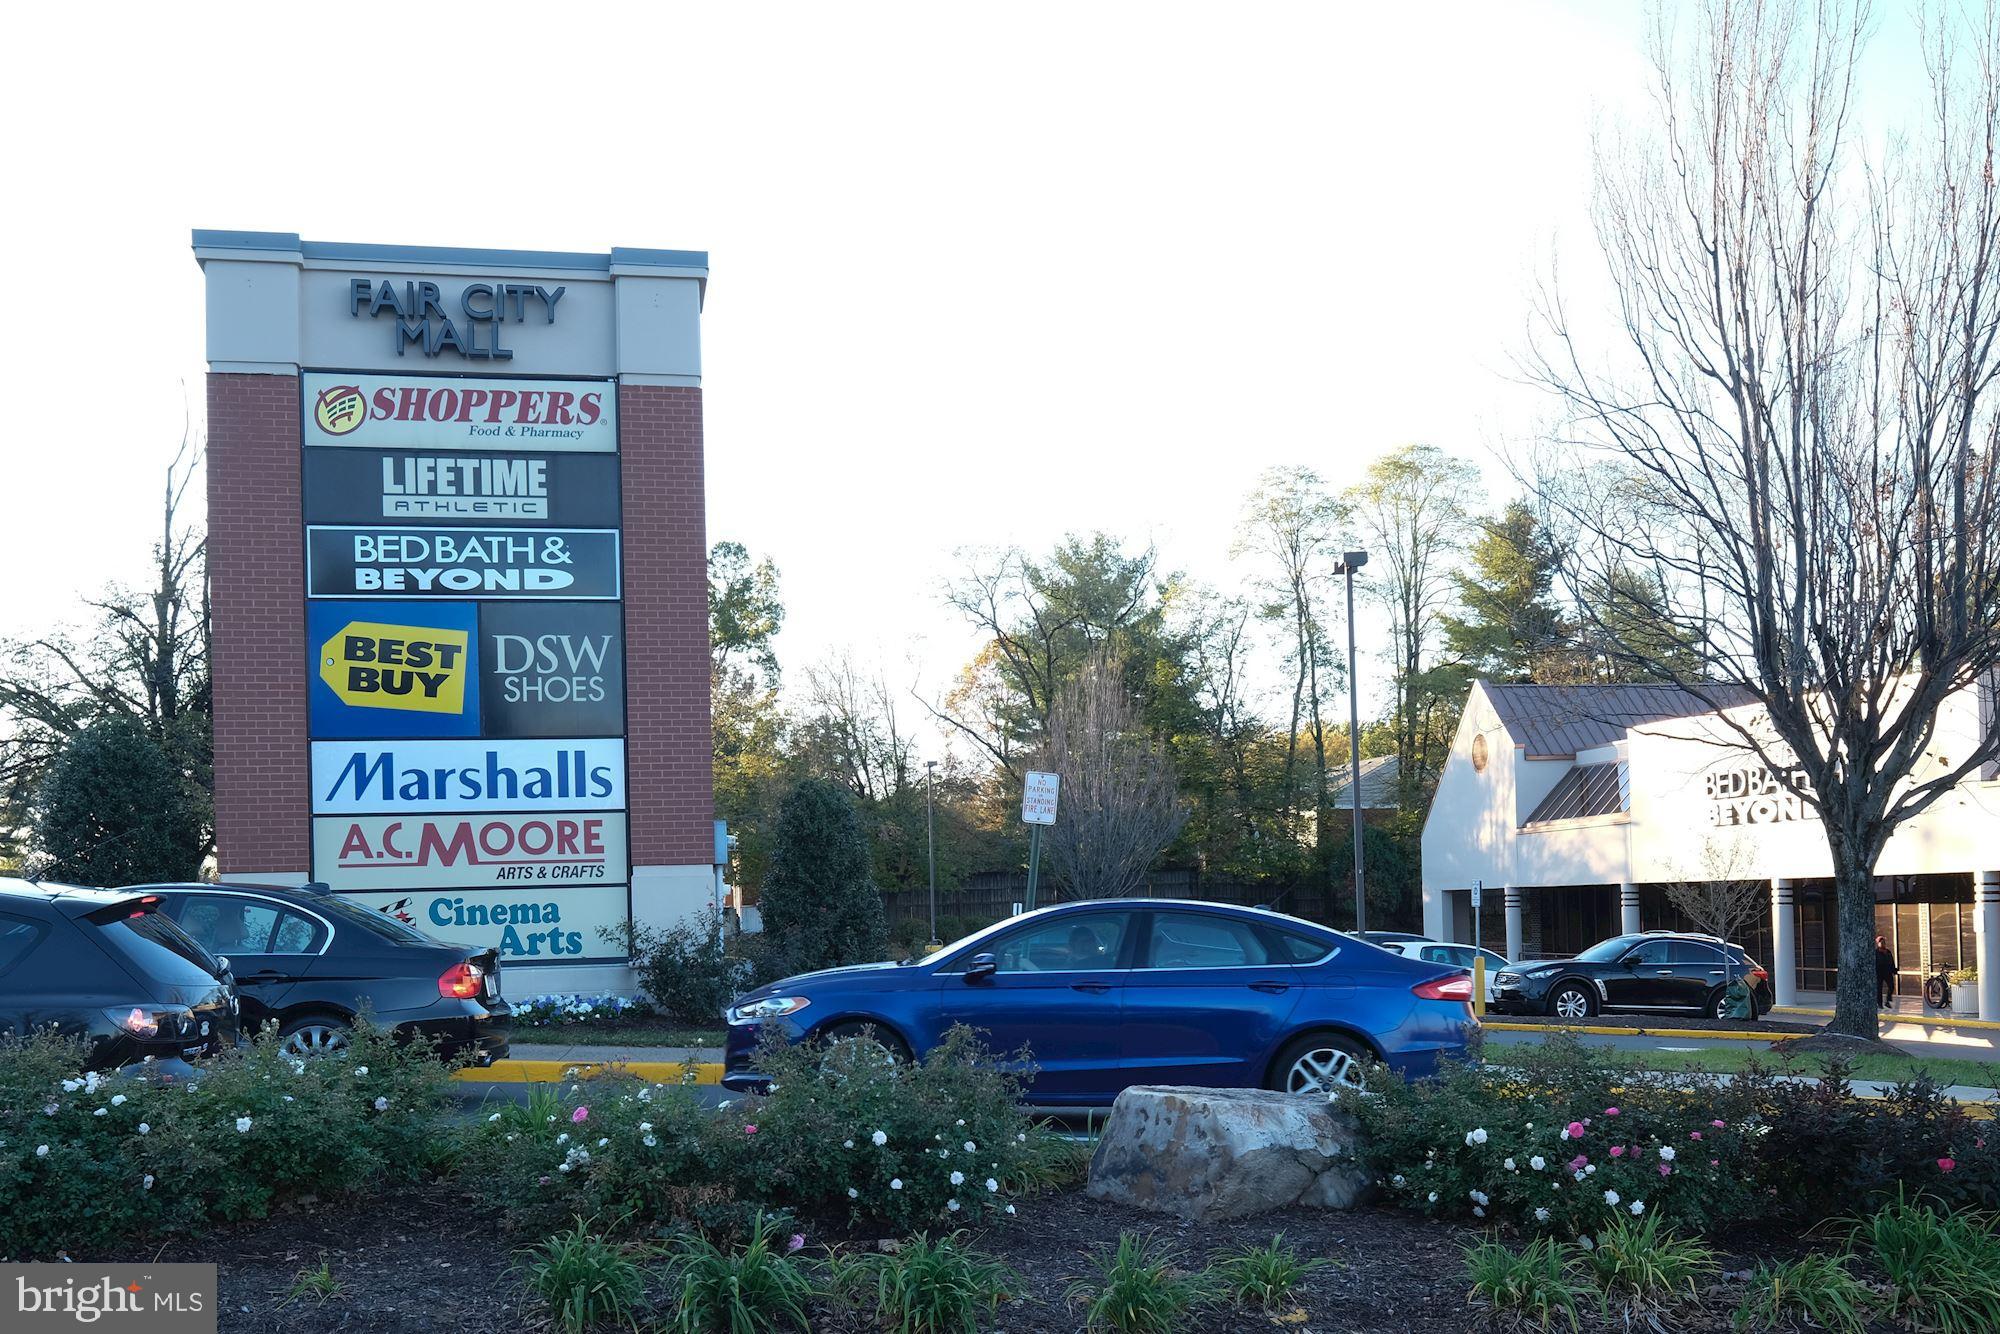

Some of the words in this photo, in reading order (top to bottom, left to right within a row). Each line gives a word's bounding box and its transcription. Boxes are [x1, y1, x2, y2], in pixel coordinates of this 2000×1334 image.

[350, 278, 446, 320] FAIR
[461, 283, 566, 324] CITY
[396, 317, 514, 360] MALL
[369, 387, 602, 426] SHOPPERS
[469, 424, 501, 438] Food
[504, 425, 517, 438] &
[520, 425, 584, 440] Pharmacy
[382, 456, 547, 497] LIFETIME
[394, 500, 537, 514] ATHLETIC
[354, 536, 431, 564] BED
[436, 535, 535, 564] BATH
[540, 536, 571, 564] &
[355, 567, 574, 591] BEYOND
[343, 635, 462, 670] BEST
[492, 634, 613, 675] DSW
[347, 666, 450, 698] BUY
[503, 676, 605, 703] SHOES
[325, 750, 613, 802] Marshalls
[1027, 785, 1055, 795] PARKING
[1024, 804, 1037, 814] FIRE
[1039, 806, 1055, 815] LANE
[1026, 797, 1055, 806] STANDING
[496, 866, 534, 881] ARTS
[537, 865, 548, 880] &
[550, 864, 605, 880] CRAFTS
[428, 896, 561, 927] Cinema
[499, 924, 583, 957] Arts
